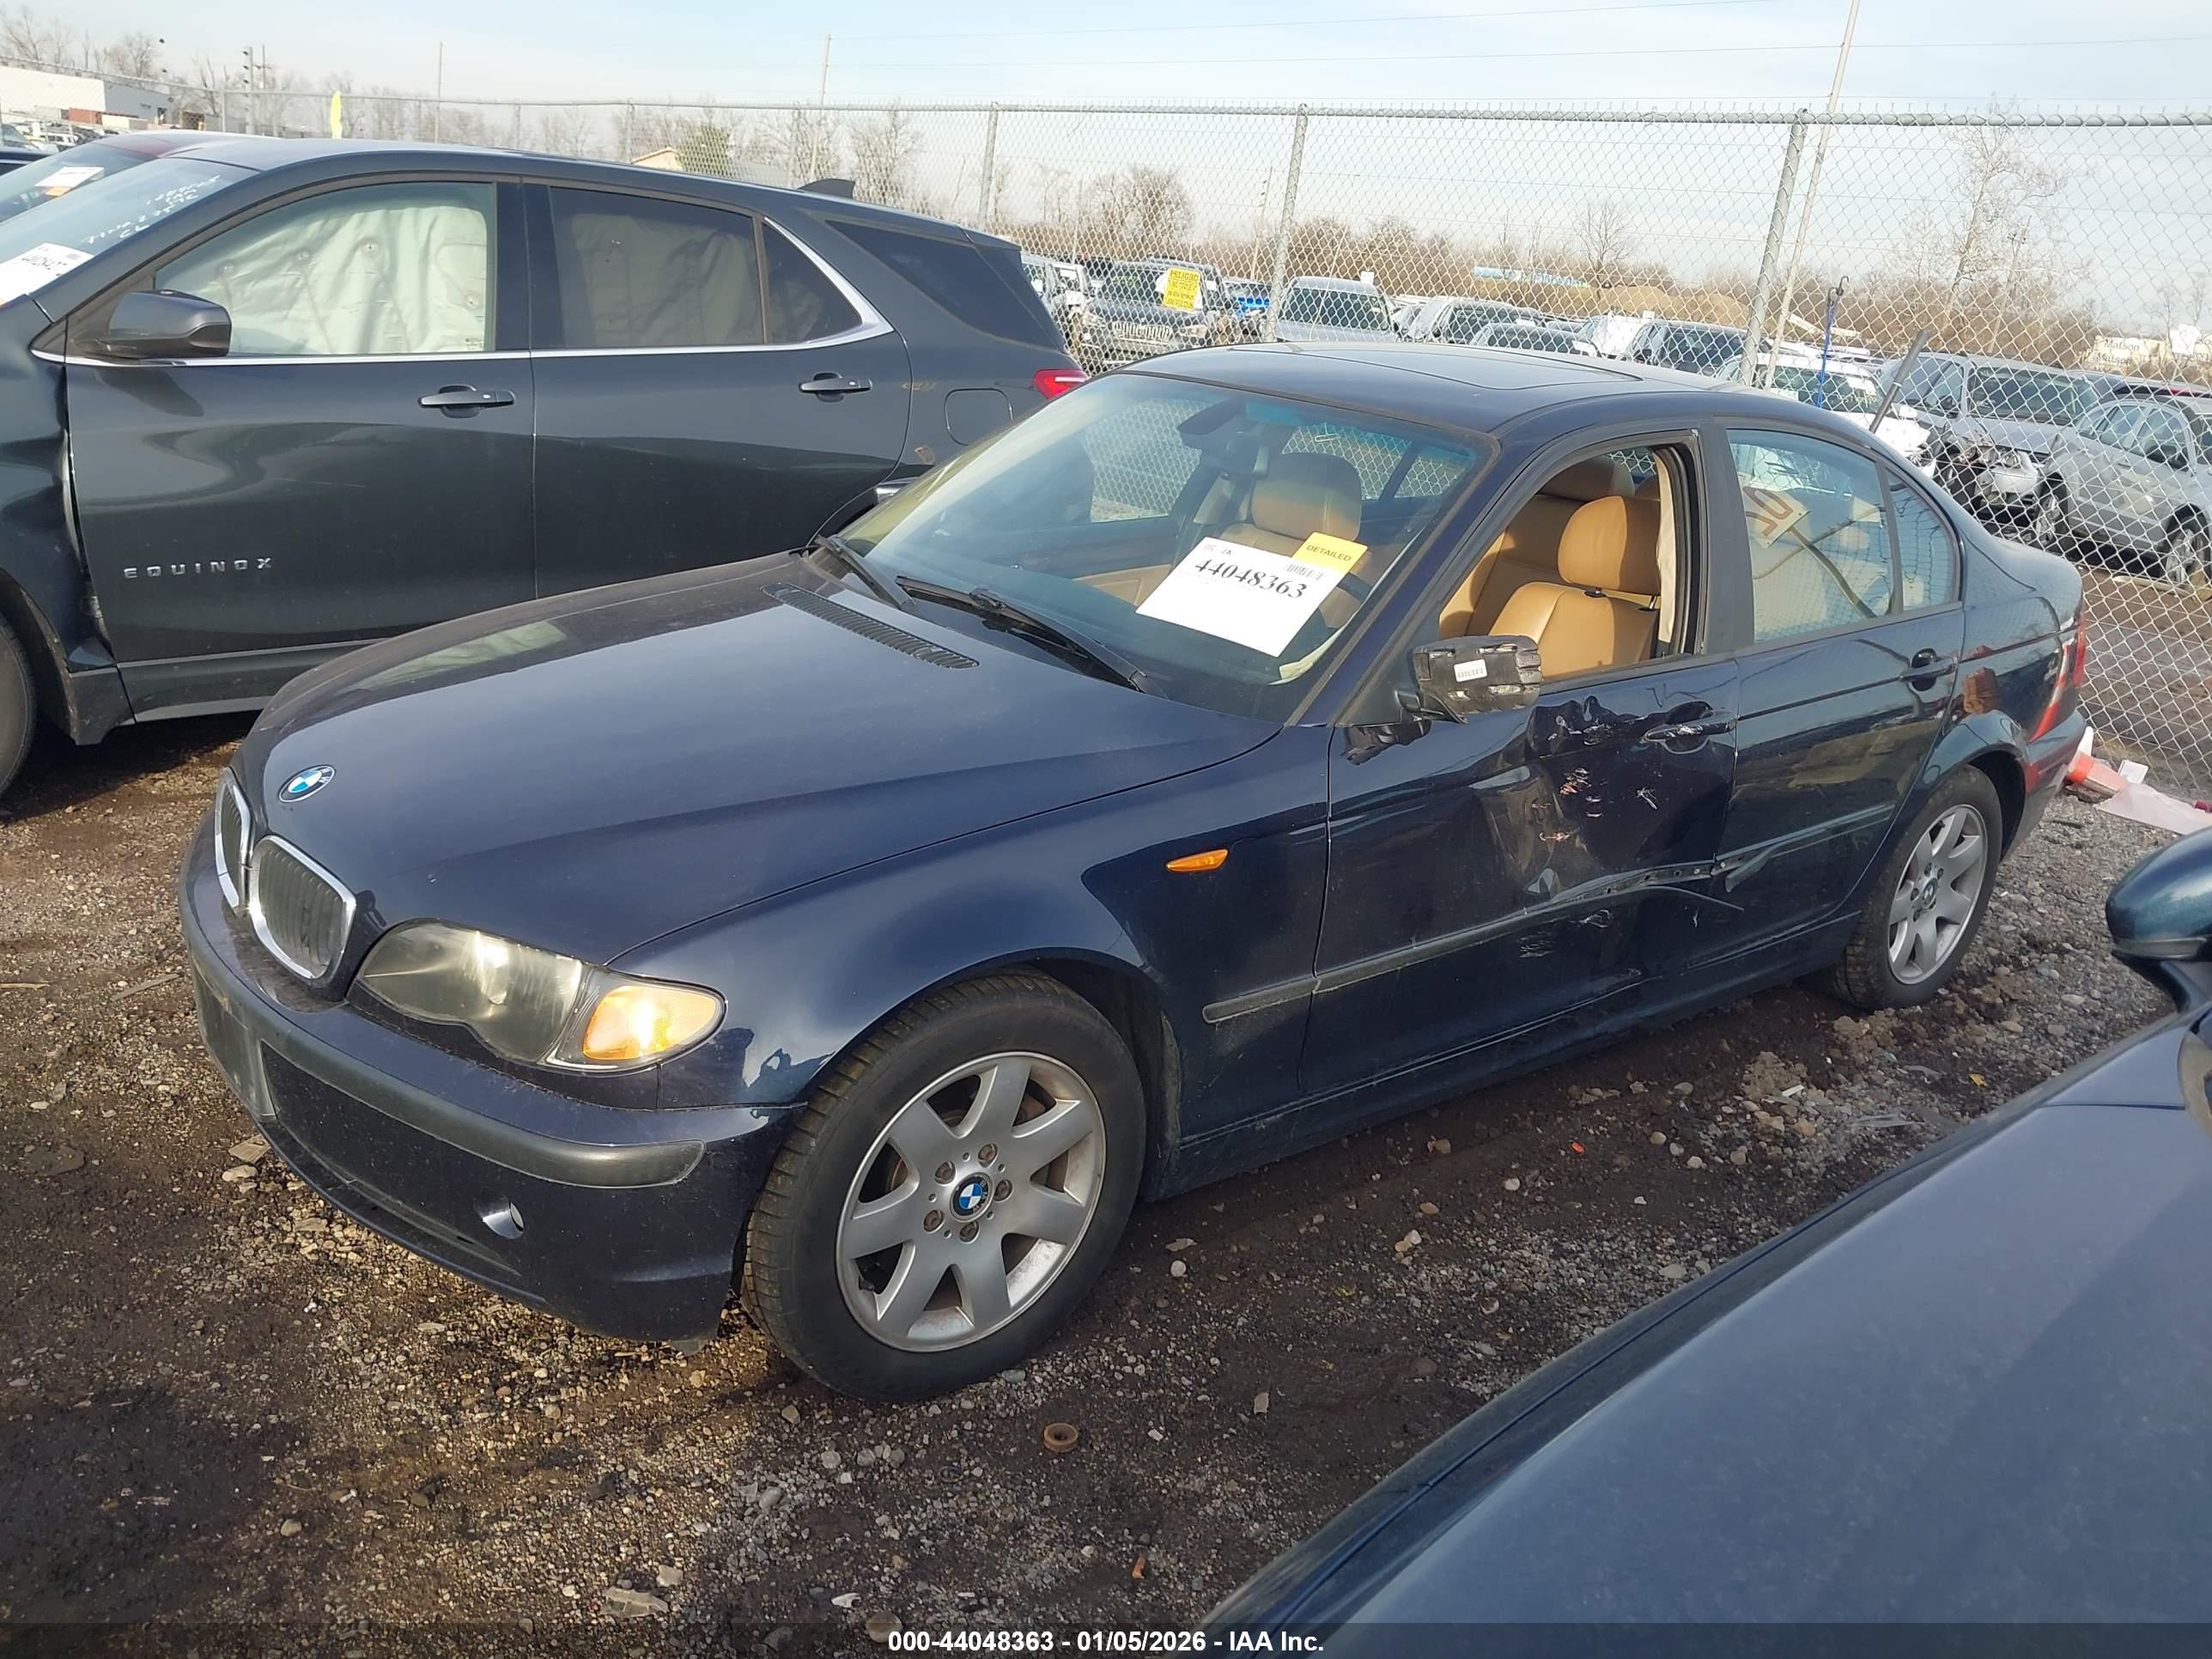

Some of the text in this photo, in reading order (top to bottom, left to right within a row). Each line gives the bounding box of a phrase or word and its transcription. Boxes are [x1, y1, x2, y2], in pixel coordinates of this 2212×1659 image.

[1305, 544, 1352, 562] DETAILED
[124, 556, 272, 579] EQUINOX
[1194, 558, 1308, 599] 44048363
